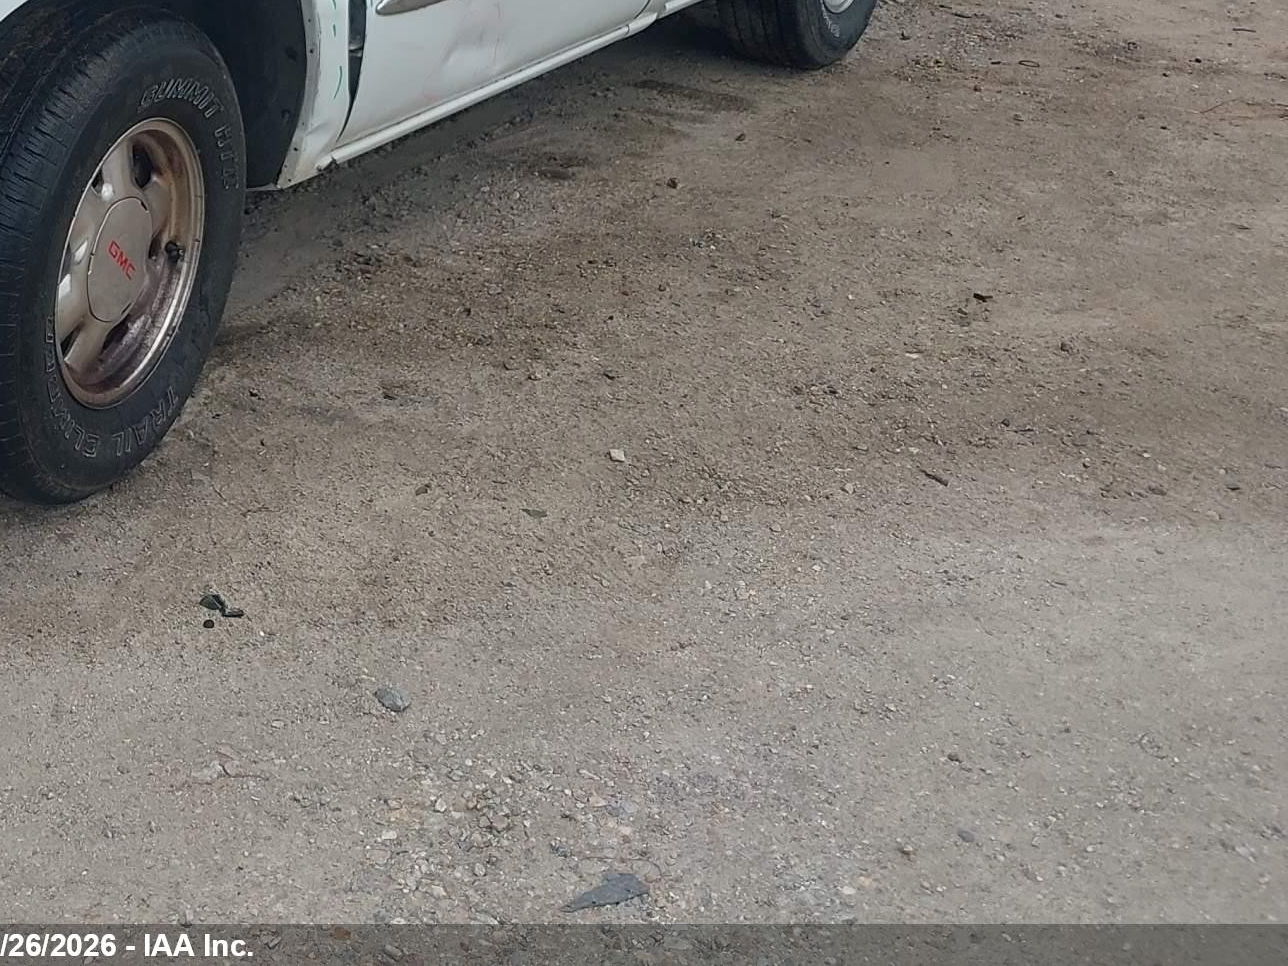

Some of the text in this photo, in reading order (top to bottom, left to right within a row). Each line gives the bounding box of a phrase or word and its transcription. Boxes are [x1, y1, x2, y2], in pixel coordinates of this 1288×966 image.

[136, 77, 225, 119] SUMMIT
[108, 240, 136, 281] GMC
[112, 386, 179, 457] TRAIL
